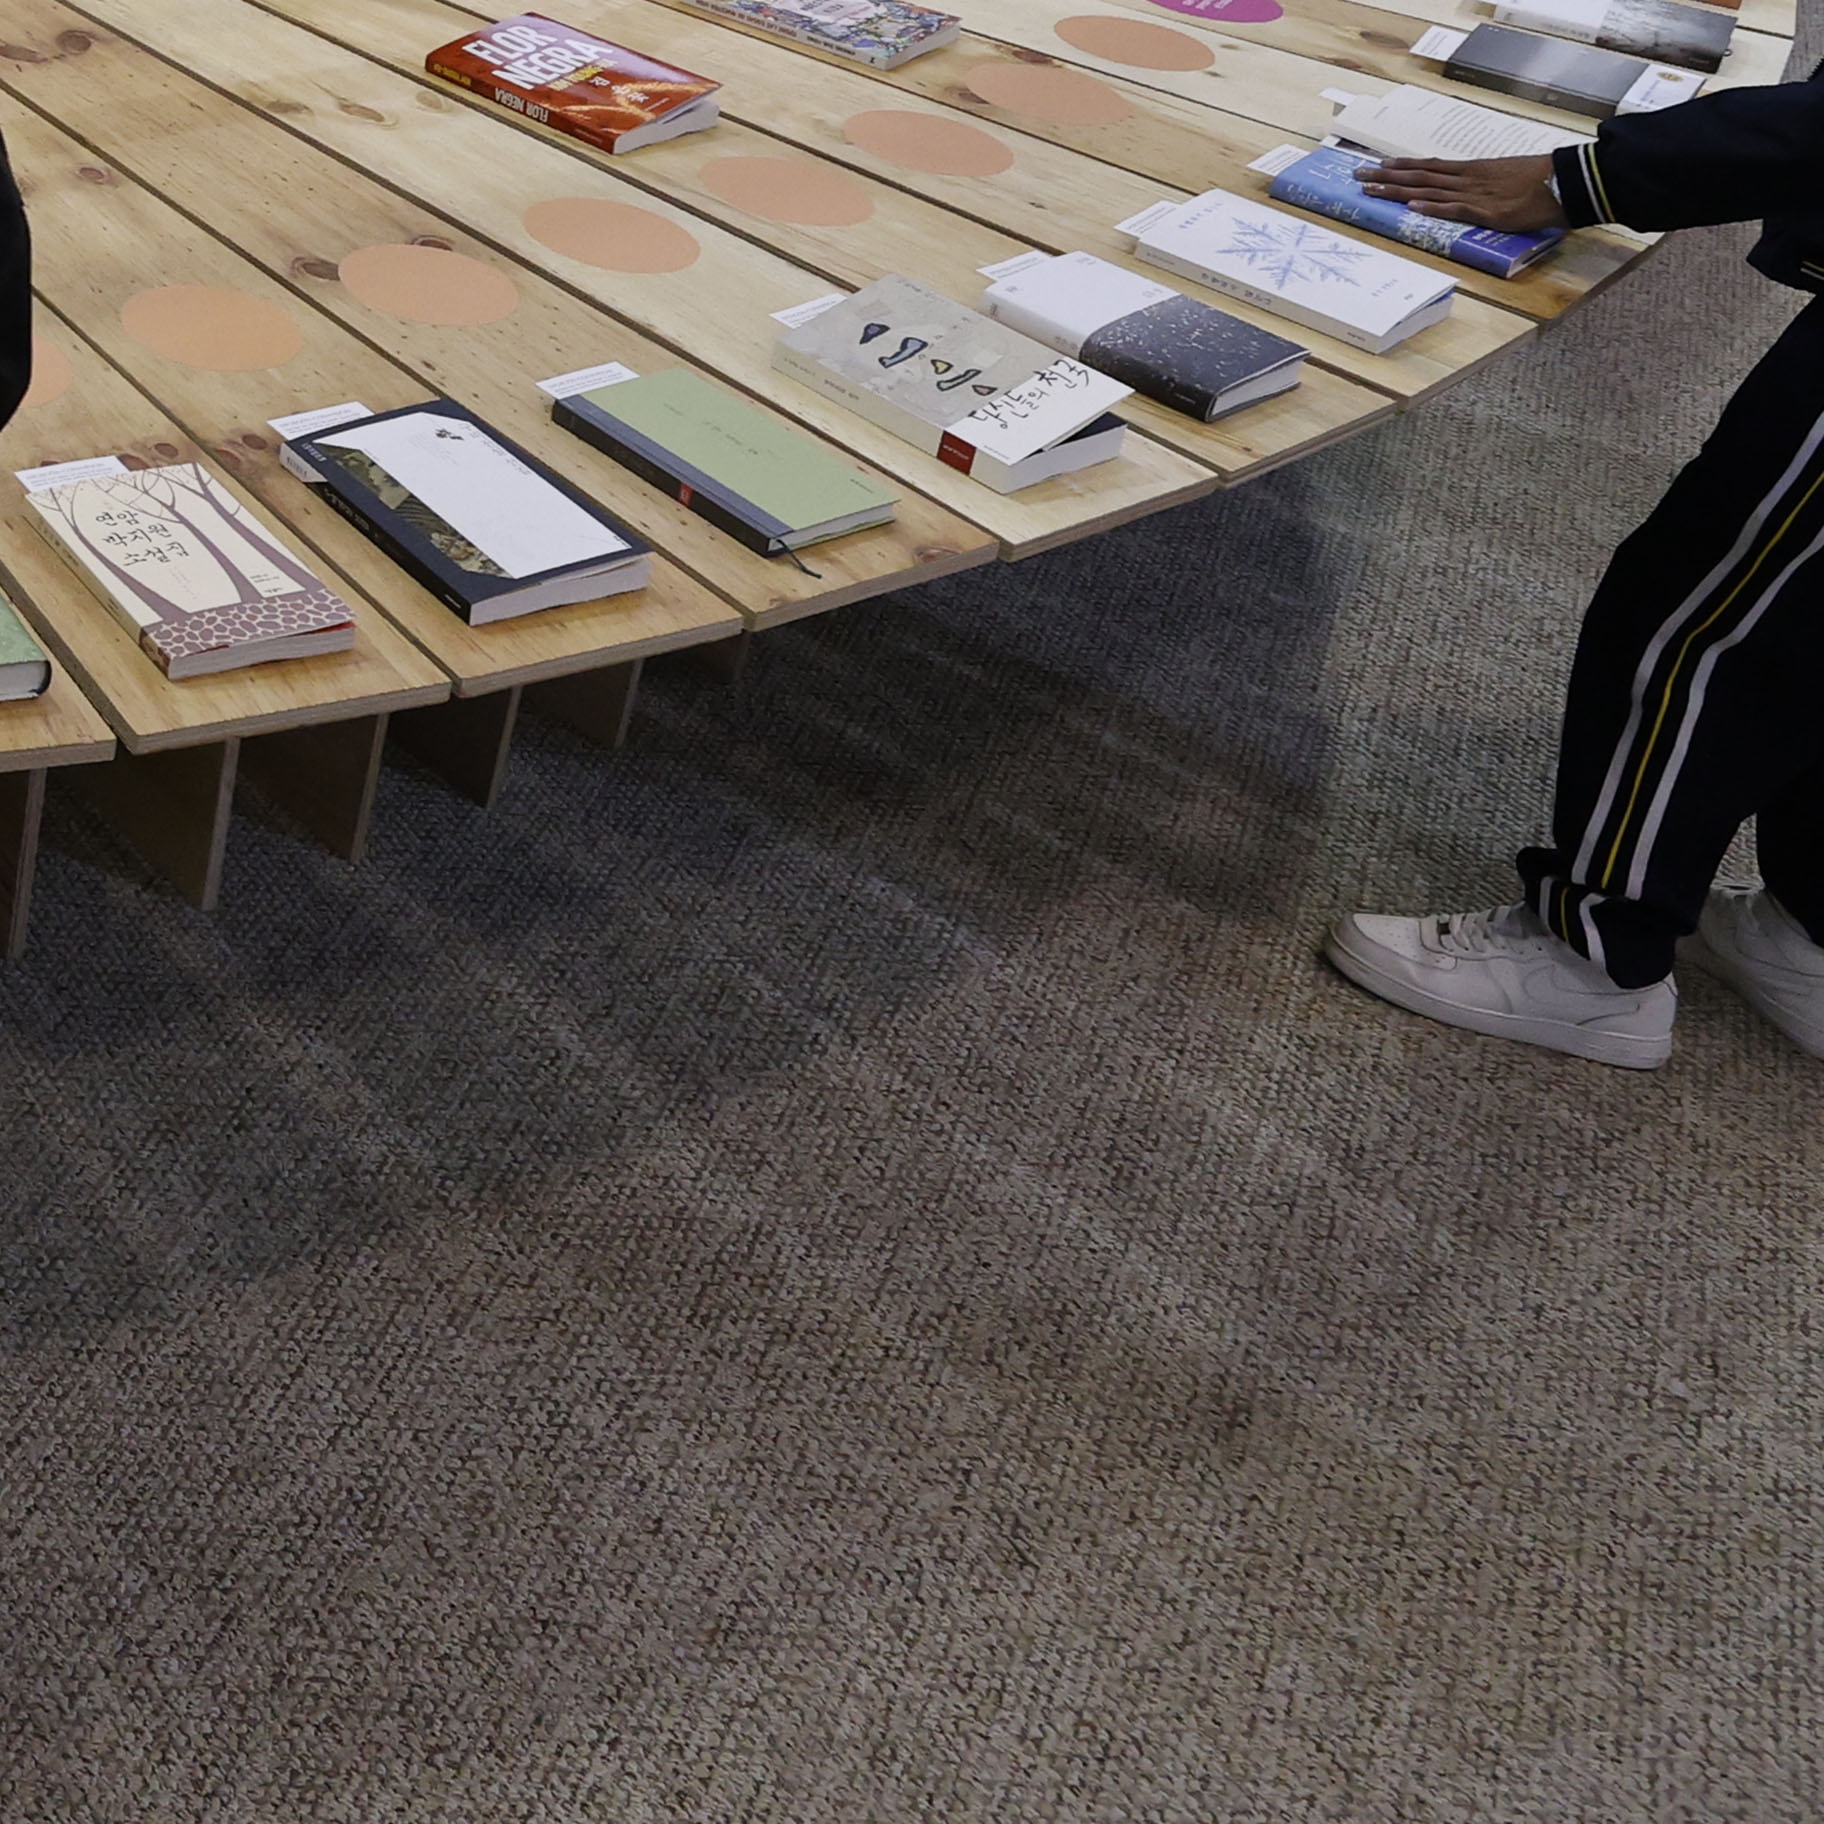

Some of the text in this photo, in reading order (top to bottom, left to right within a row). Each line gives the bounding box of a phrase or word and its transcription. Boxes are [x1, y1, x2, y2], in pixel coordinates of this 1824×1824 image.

[461, 25, 557, 66] FLOR
[491, 38, 613, 90] NEGRA
[494, 87, 525, 113] NEGRA
[526, 104, 550, 124] FLOR
[967, 358, 1091, 430] 당신들의 천국
[95, 511, 141, 526] 연암
[102, 522, 174, 547] 박지원
[123, 541, 191, 567] 소설집
